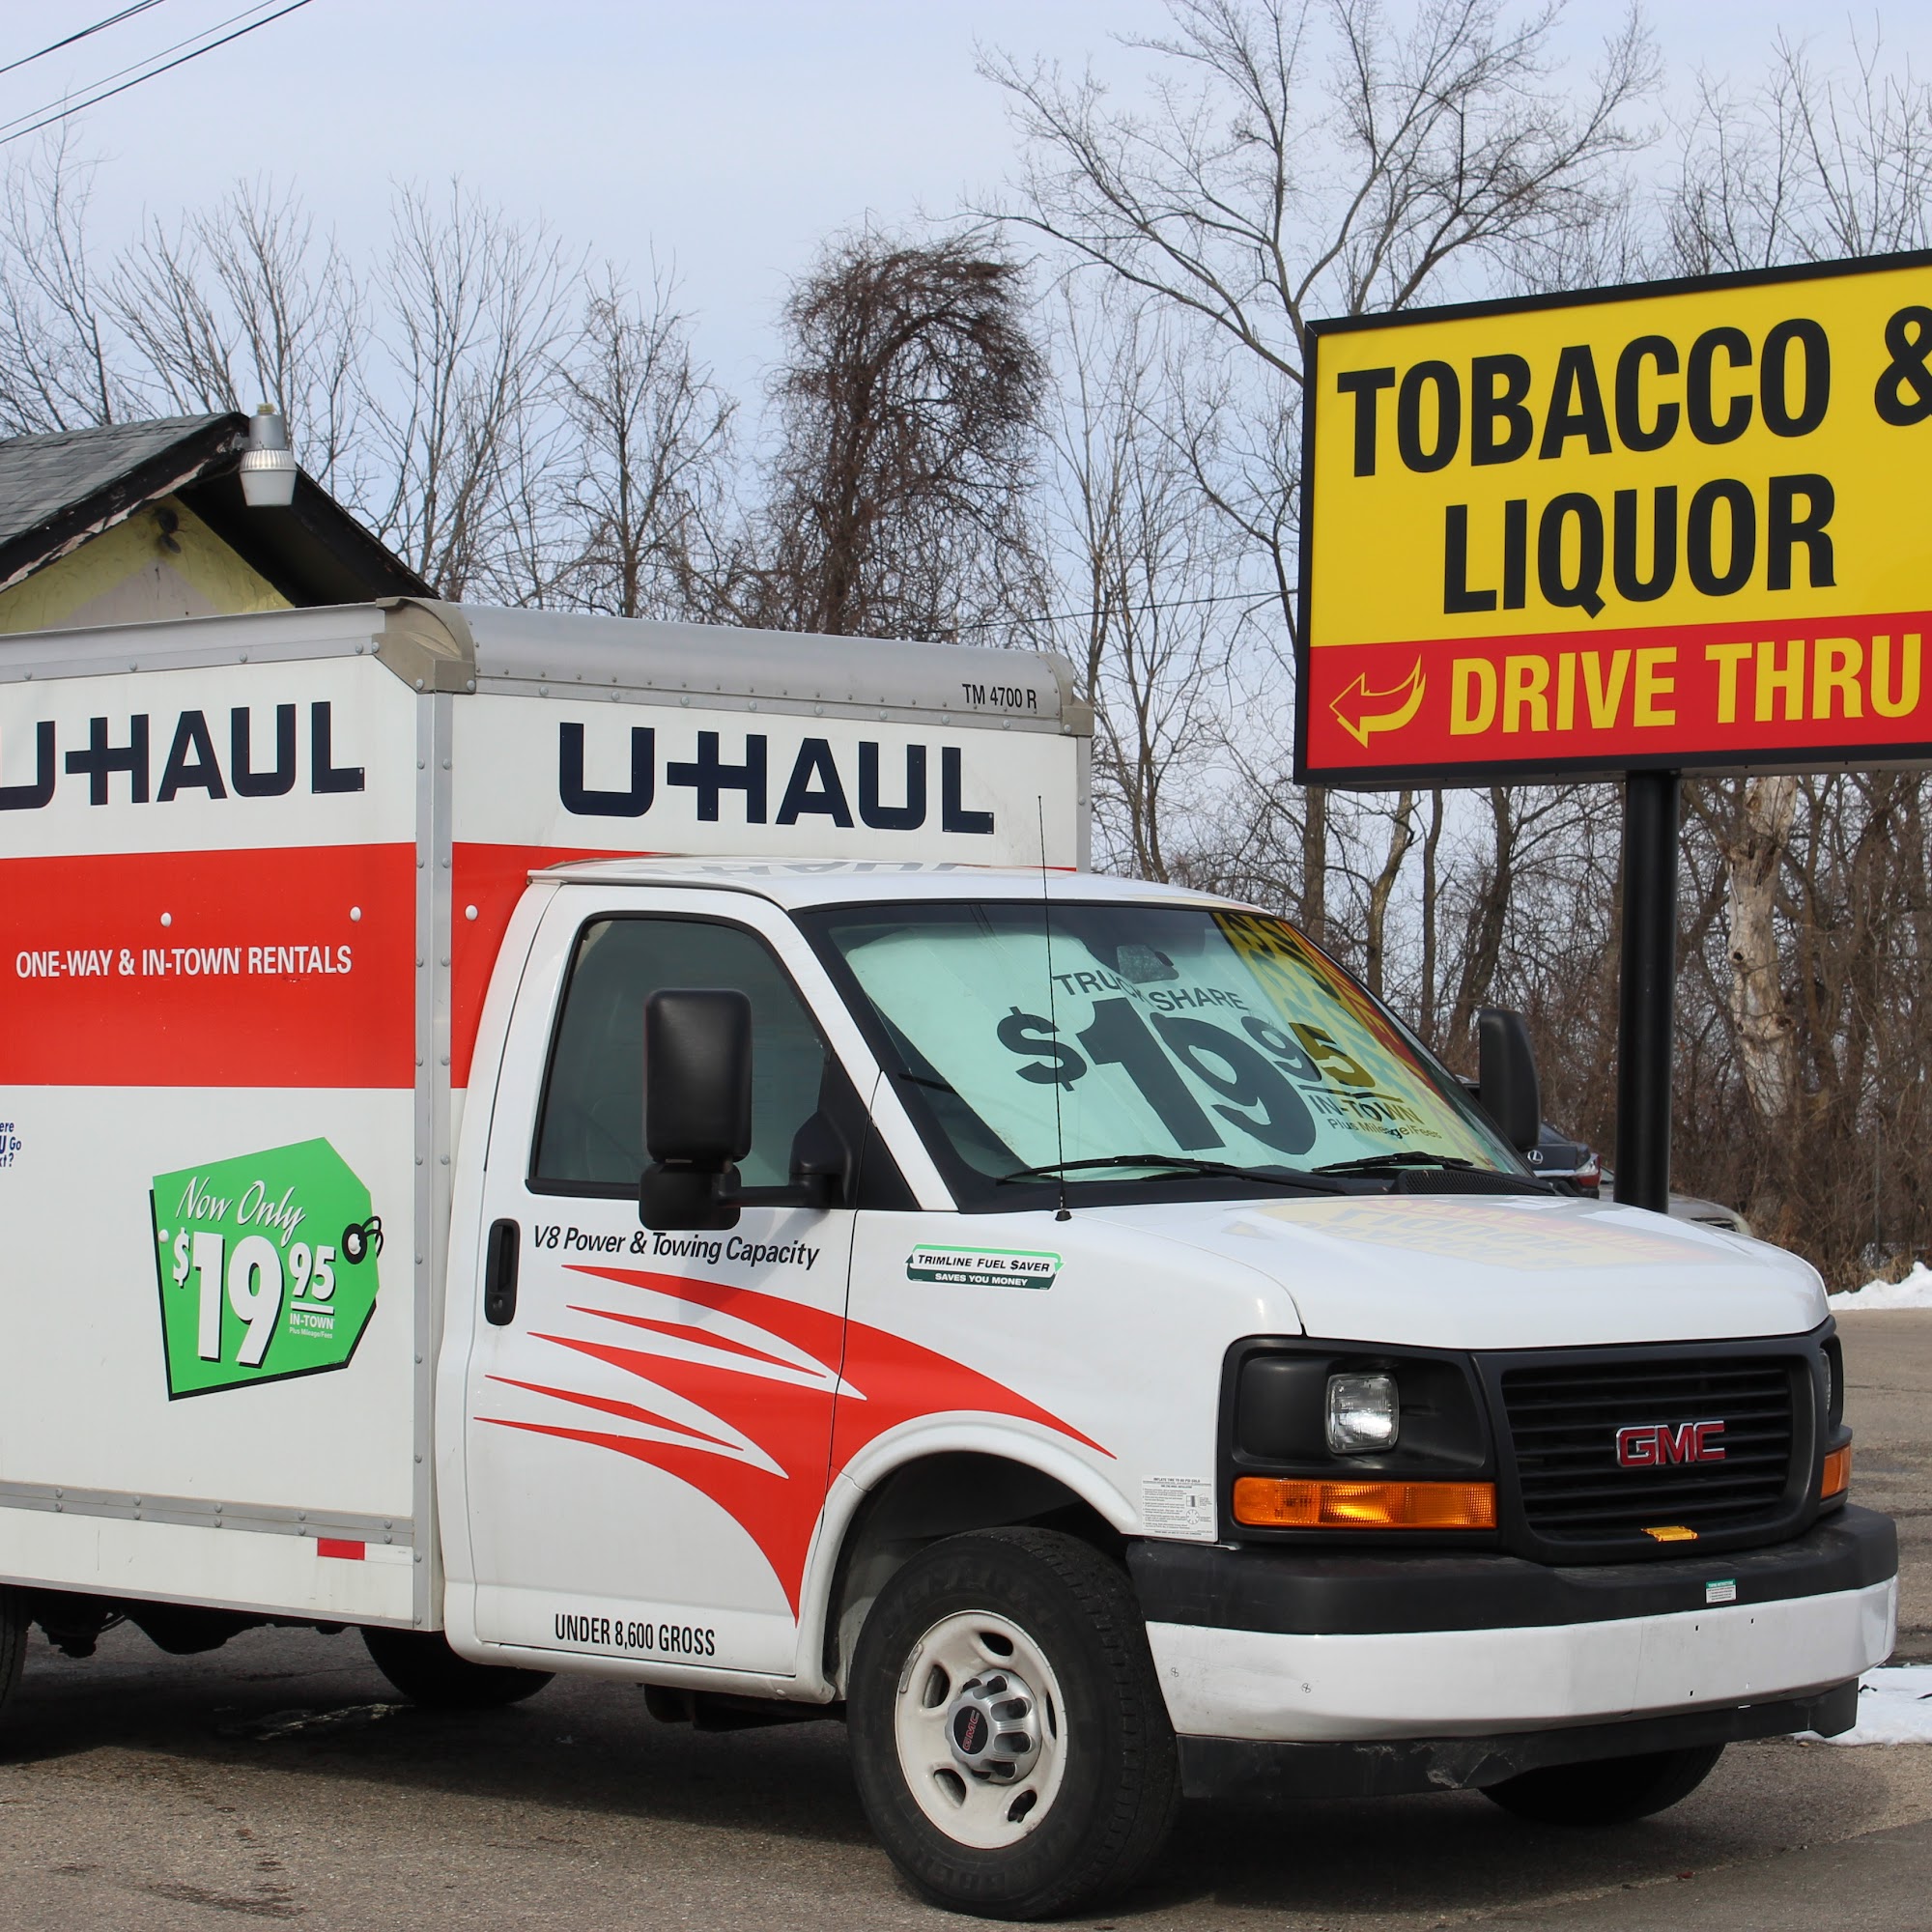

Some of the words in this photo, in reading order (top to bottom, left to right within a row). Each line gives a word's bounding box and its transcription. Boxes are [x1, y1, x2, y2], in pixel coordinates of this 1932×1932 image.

[1336, 318, 1832, 478] TOBACCO
[1873, 305, 1932, 427] &
[1443, 472, 1837, 619] LIQUOR
[962, 683, 985, 705] TM
[989, 686, 1023, 708] 4700
[1026, 689, 1037, 709] R
[1449, 645, 1678, 738] DRIVE
[1704, 633, 1922, 724] THRU
[559, 722, 995, 835] U-HAUL
[15, 950, 113, 979] ONE-WAY
[118, 949, 135, 976] &
[142, 948, 241, 975] IN-TOWN
[248, 945, 353, 975] RENTALS
[1052, 970, 1153, 1008] TRUCK
[1149, 986, 1250, 1011] SHARE
[0, 1122, 14, 1133] ere
[1308, 1094, 1425, 1125] IN-TOWN
[1327, 1118, 1358, 1131] Plus
[10, 1136, 22, 1151] Go
[175, 1176, 234, 1222] Now
[236, 1179, 307, 1249] Only
[534, 1225, 560, 1249] V8
[564, 1227, 625, 1253] Power
[629, 1231, 647, 1255] &
[652, 1232, 723, 1264] Towing
[725, 1236, 821, 1270] Capacity
[918, 1254, 973, 1267] TRIMLINE
[977, 1258, 1010, 1269] FUEL
[1009, 1259, 1050, 1272] $AVER
[935, 1272, 966, 1283] SAVES
[969, 1274, 989, 1285] YOU
[991, 1276, 1028, 1287] MONEY
[290, 1313, 334, 1330] IN-TOWN
[1616, 1420, 1725, 1467] GMC
[554, 1613, 611, 1645] UNDER
[614, 1620, 654, 1650] 8,600
[658, 1624, 715, 1657] GROSS
[962, 1709, 980, 1751] GMC
